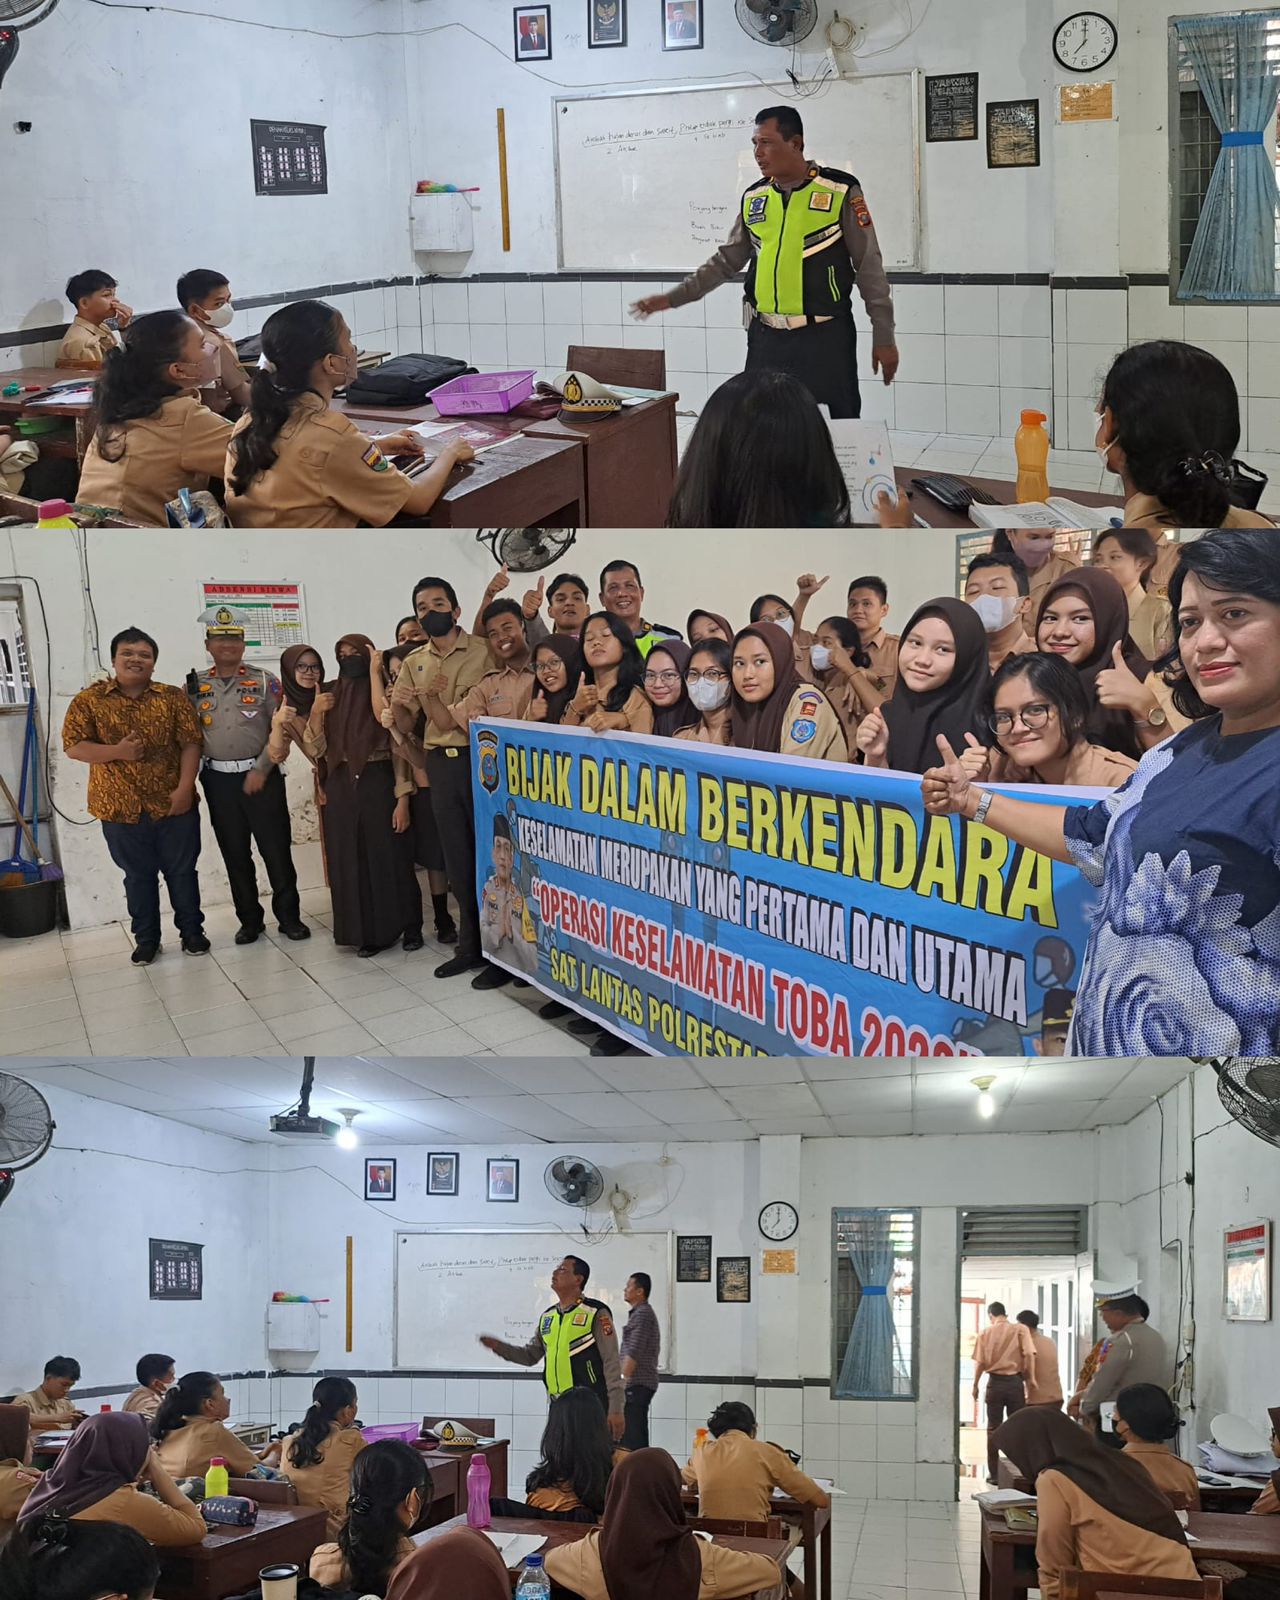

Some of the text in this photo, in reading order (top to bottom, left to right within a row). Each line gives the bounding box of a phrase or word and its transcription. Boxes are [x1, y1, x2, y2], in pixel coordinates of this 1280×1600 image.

[505, 744, 1058, 929] BIJAK DALAM BERKENDARA
[517, 815, 1028, 1027] KESELAMATAN MERUPAKAN YANG PERTAMA DAN UTAMA
[551, 948, 769, 1057] SAT LANTAS POLREST
[611, 907, 765, 1021] KESELAMATAN
[772, 971, 851, 1057] TOBA
